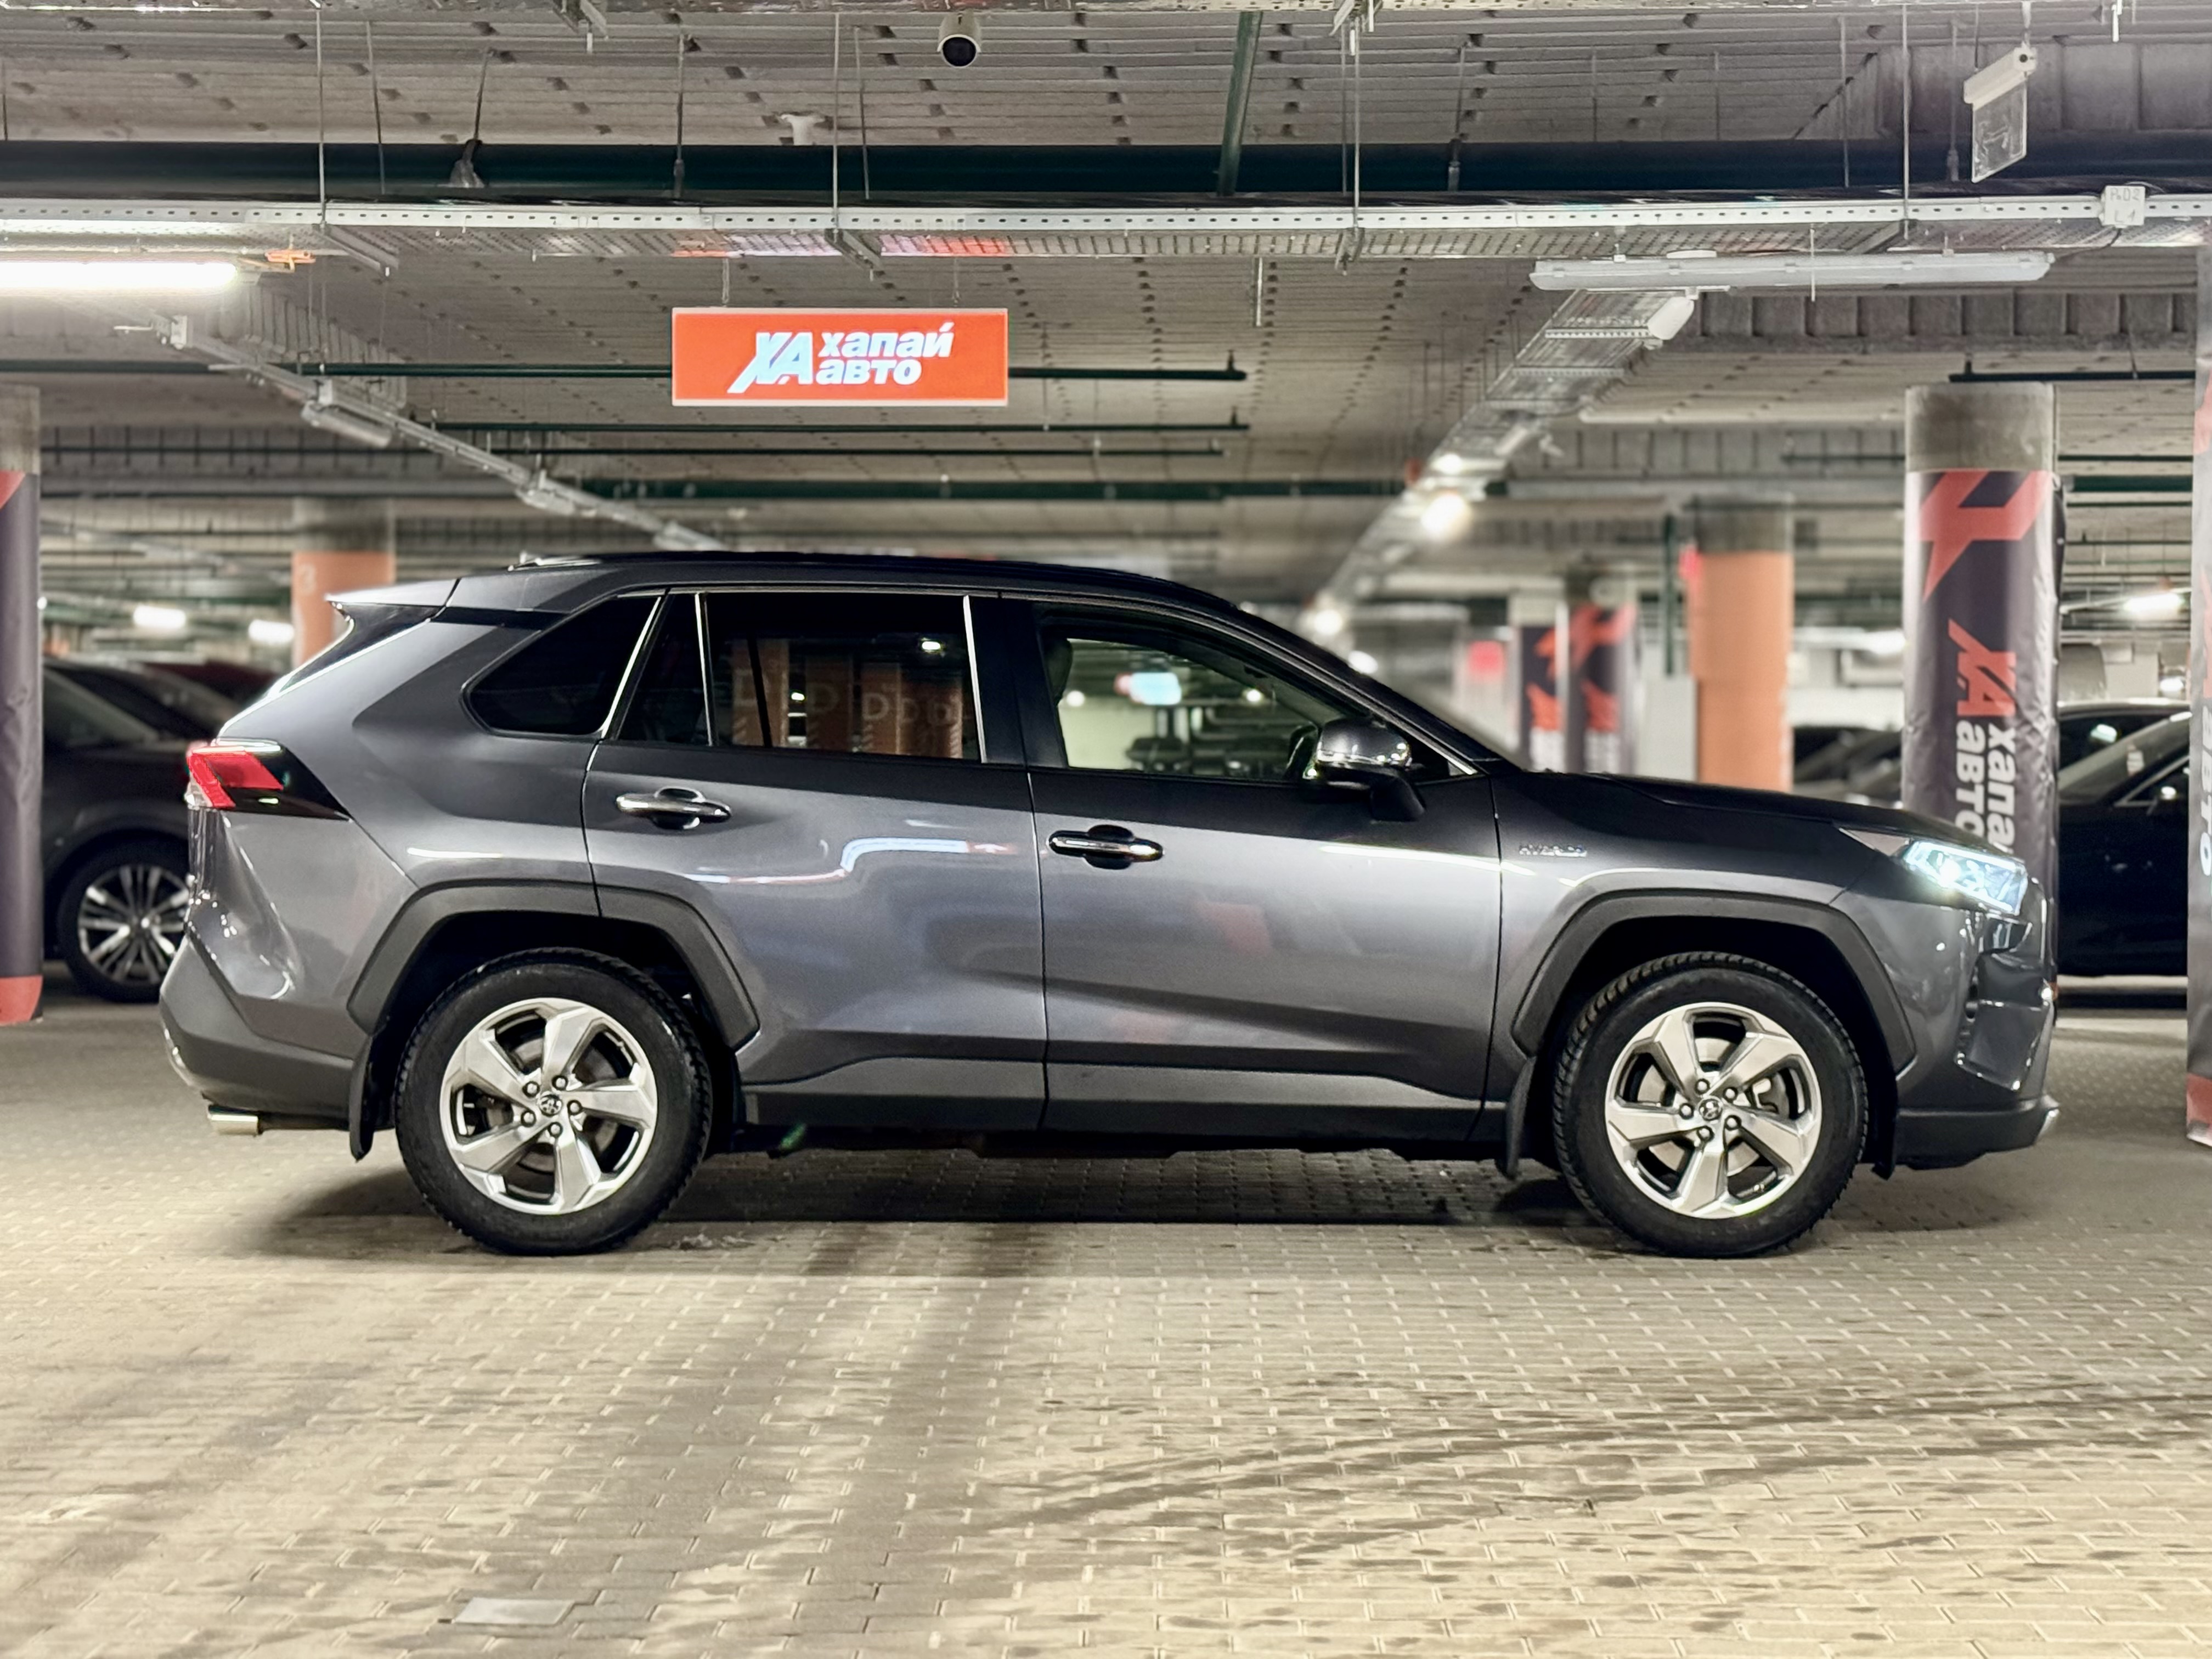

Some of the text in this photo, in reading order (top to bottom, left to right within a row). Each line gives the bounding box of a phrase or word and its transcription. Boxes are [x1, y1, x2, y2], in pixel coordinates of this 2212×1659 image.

[818, 322, 955, 358] хапай
[816, 359, 922, 385] авто
[1987, 723, 2017, 855] хапа
